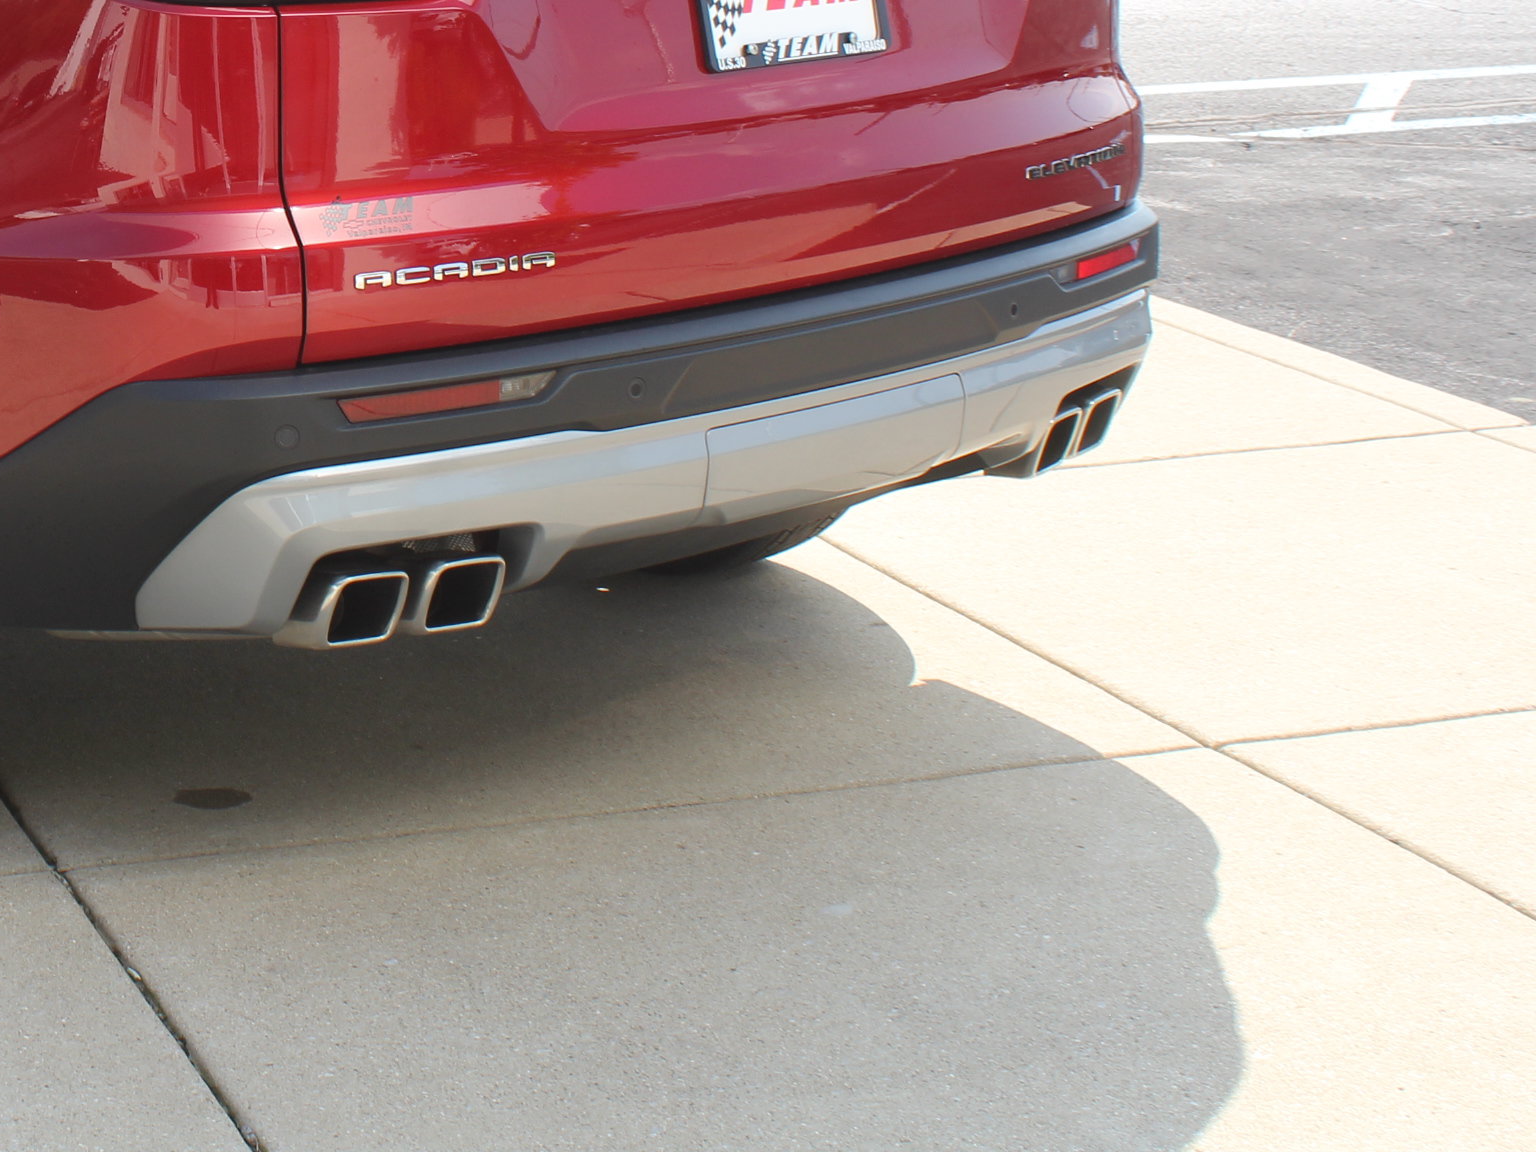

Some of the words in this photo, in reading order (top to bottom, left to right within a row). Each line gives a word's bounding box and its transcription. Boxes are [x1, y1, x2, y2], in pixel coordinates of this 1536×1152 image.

[777, 32, 841, 61] TEAM
[337, 196, 414, 221] TEAM
[353, 251, 557, 290] ACADIA
